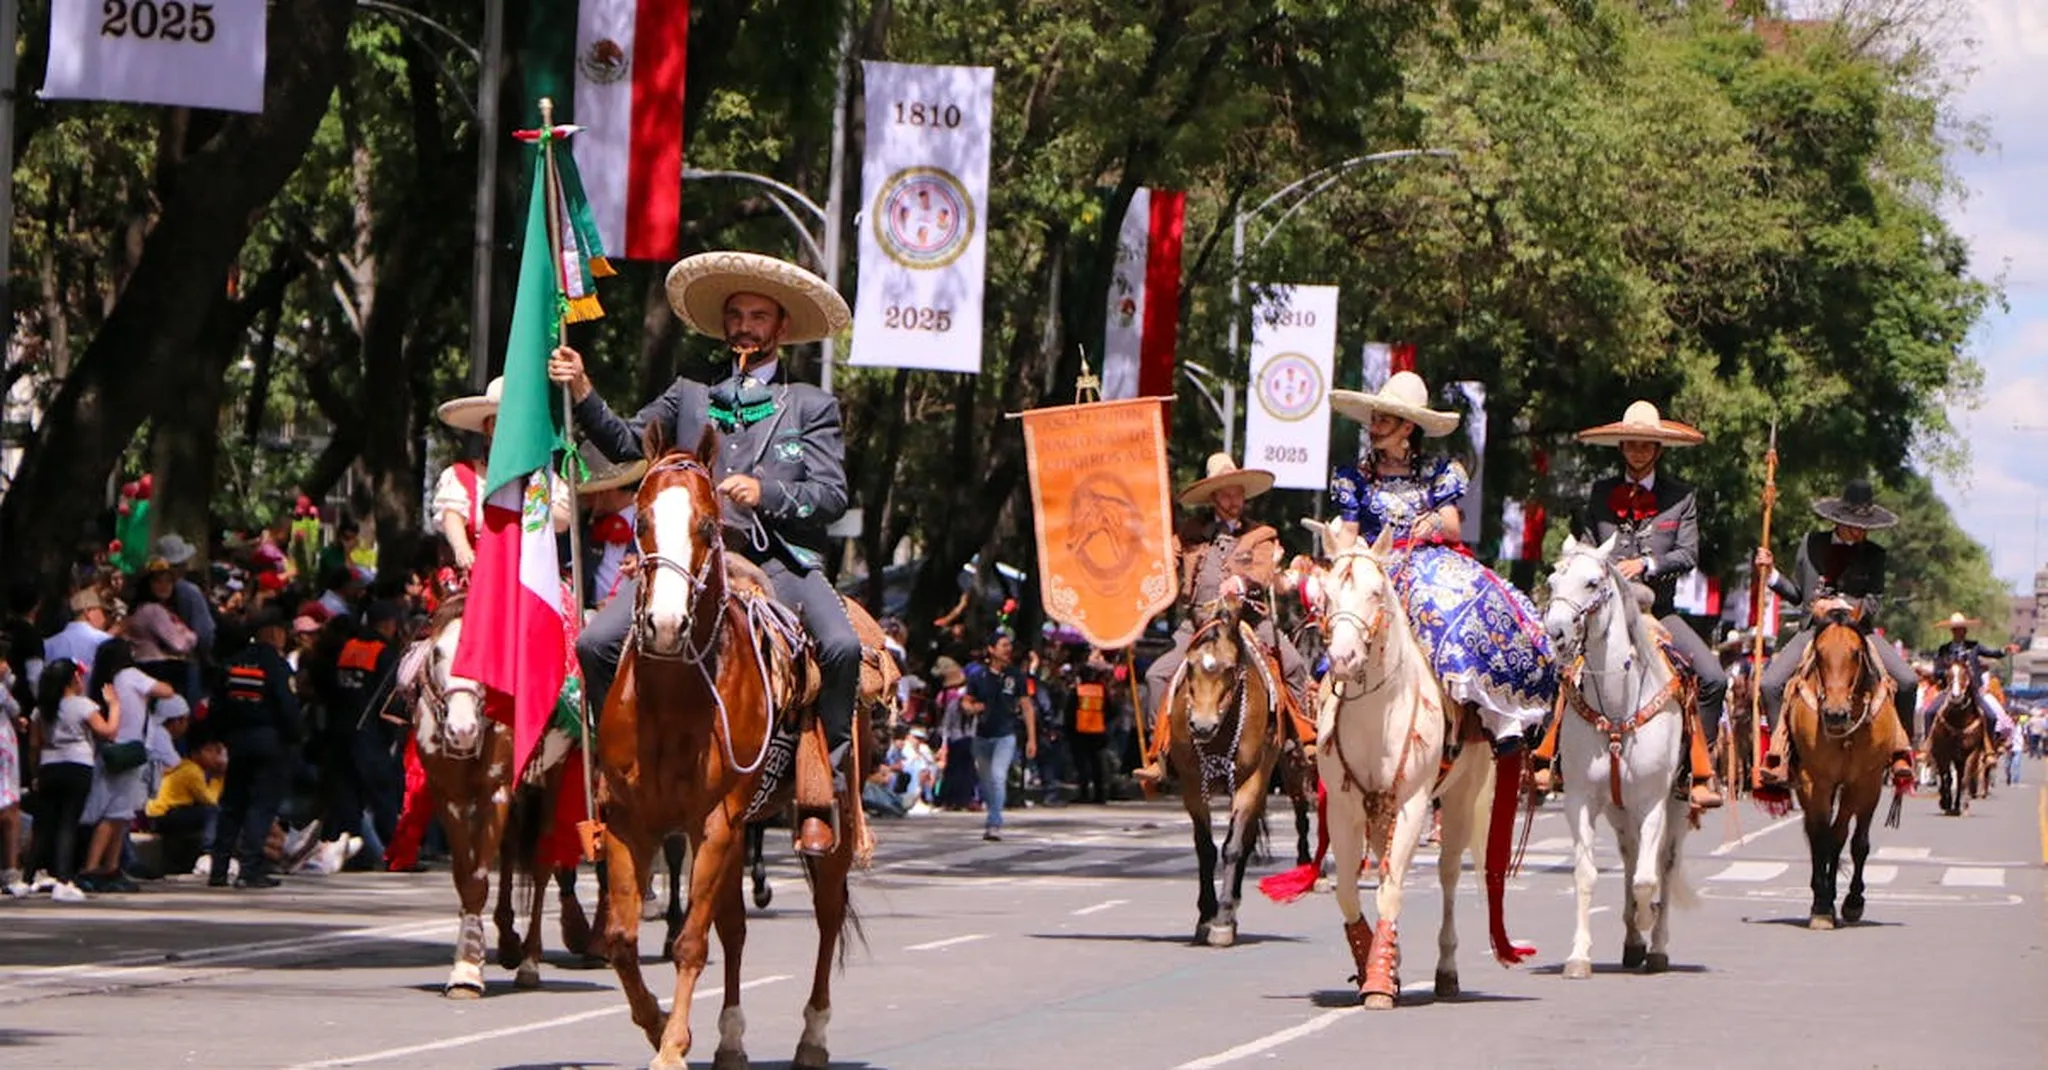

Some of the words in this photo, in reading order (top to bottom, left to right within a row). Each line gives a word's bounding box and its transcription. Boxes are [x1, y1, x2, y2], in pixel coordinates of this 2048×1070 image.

[101, 0, 216, 44] 2025
[893, 101, 962, 129] 1810
[884, 303, 952, 332] 2025
[1268, 310, 1316, 328] 810
[1264, 444, 1309, 464] 2025
